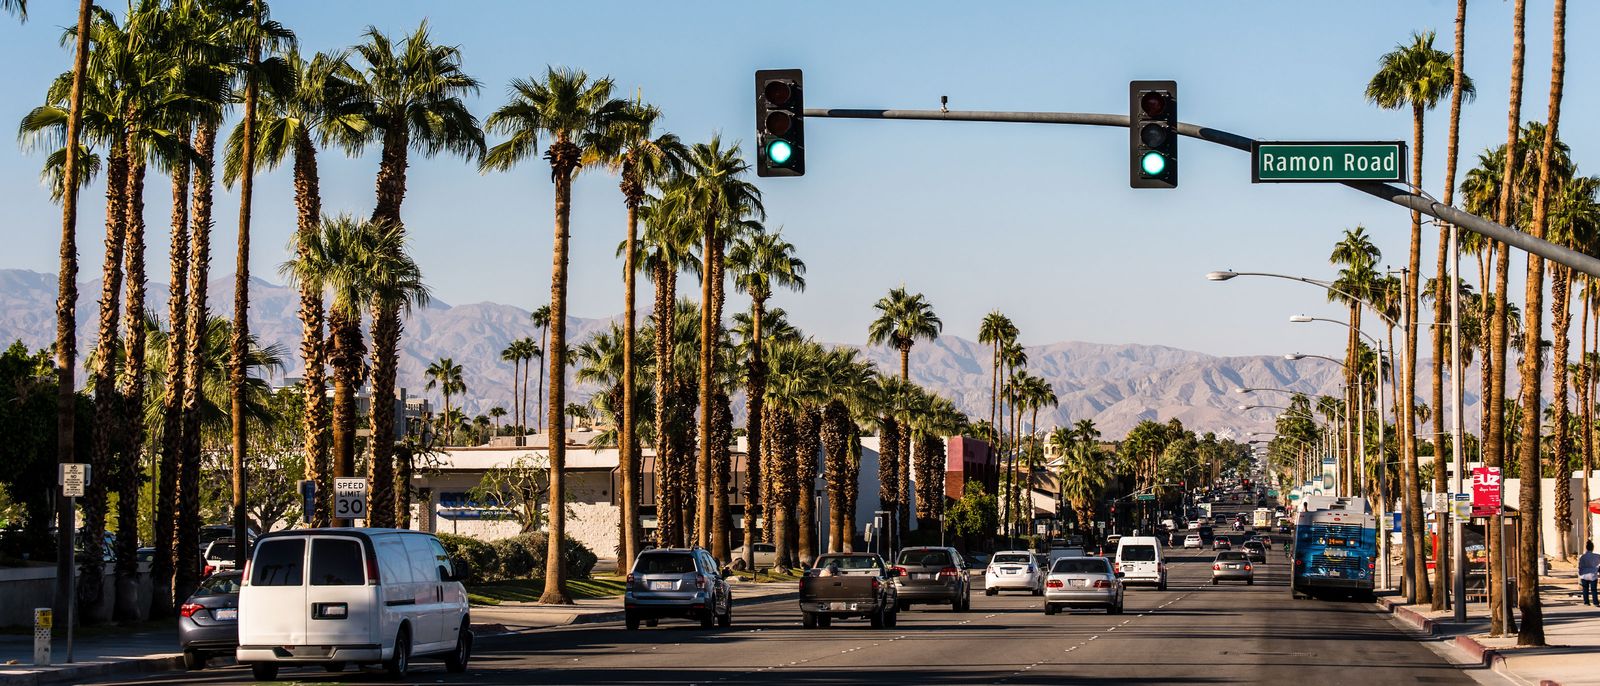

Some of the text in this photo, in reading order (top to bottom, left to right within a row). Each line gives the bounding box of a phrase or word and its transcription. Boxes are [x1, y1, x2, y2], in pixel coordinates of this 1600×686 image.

[1263, 152, 1394, 171] Ramon Road
[338, 499, 363, 514] 30
